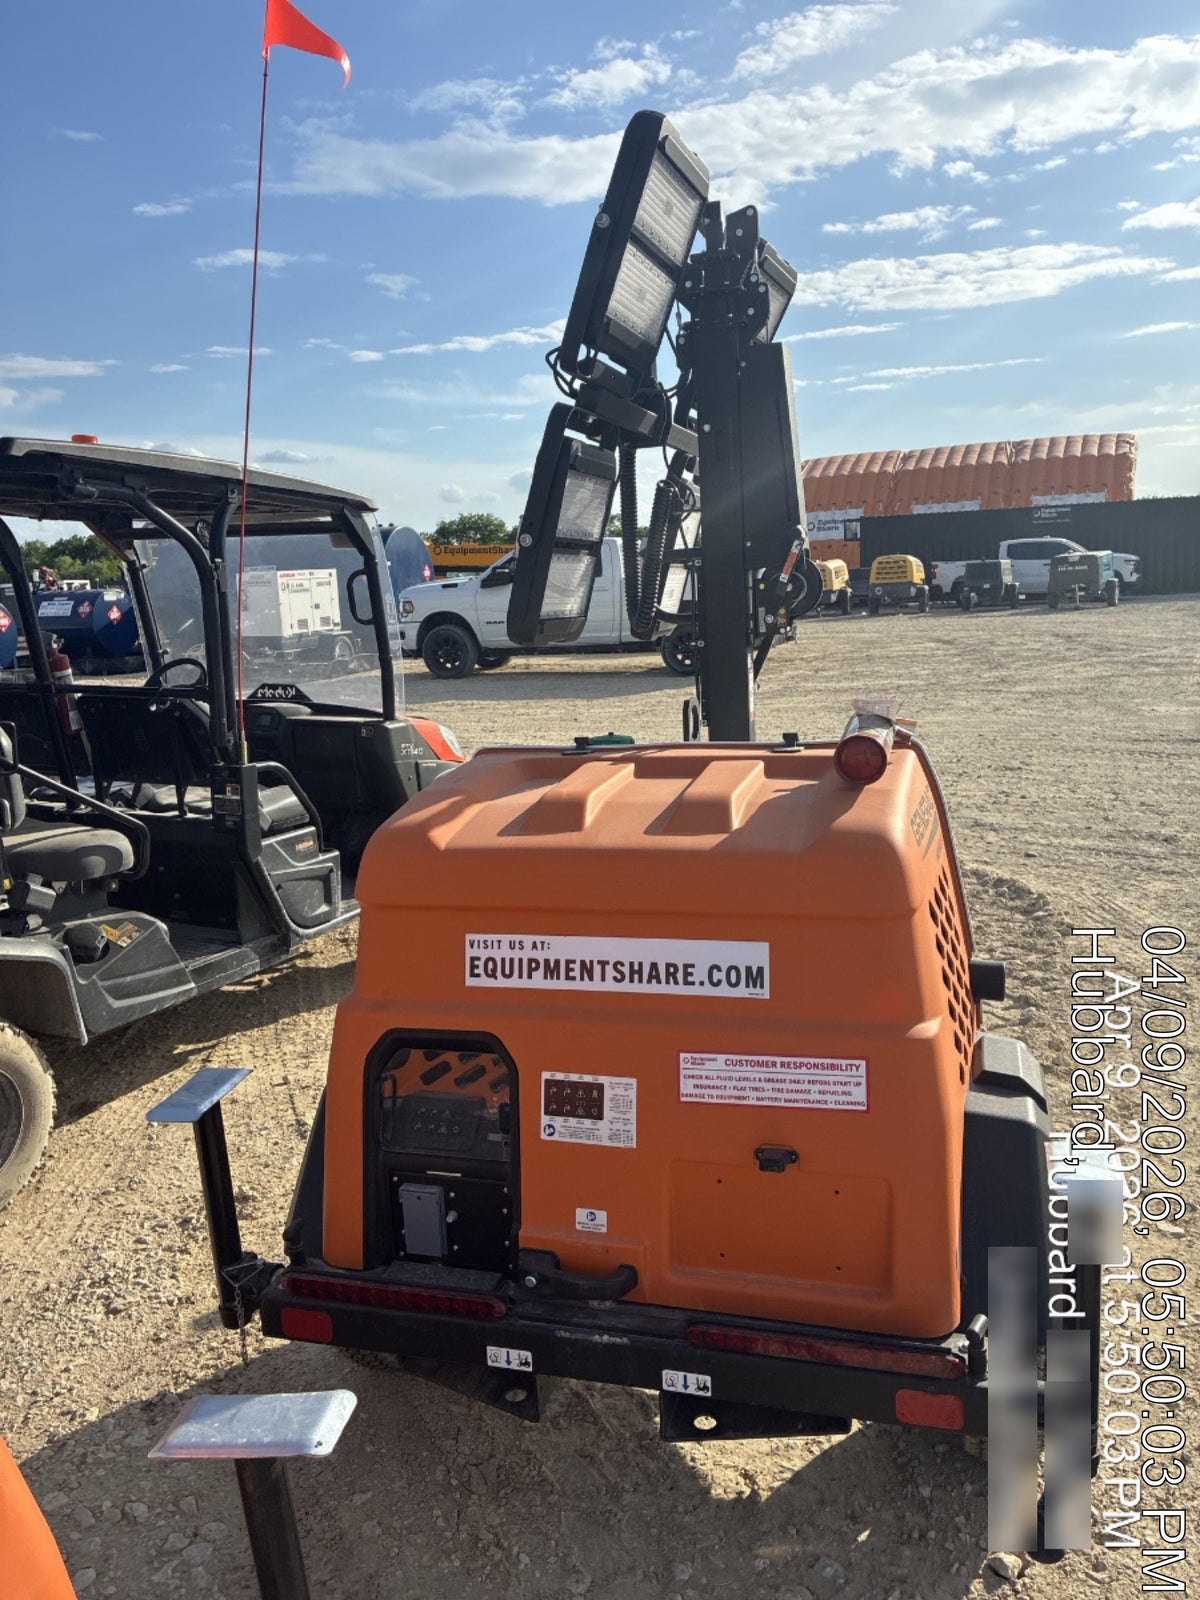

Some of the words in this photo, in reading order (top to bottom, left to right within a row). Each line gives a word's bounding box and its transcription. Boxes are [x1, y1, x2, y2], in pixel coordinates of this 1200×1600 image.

[443, 546, 516, 556] EquipmentSha
[468, 939, 503, 950] VISIT
[509, 940, 525, 950] US
[531, 941, 550, 951] AT:
[469, 956, 765, 989] EQUIPMENTSHARE.COM
[724, 1058, 778, 1069] CUSTOMER
[780, 1061, 861, 1073] RESPONSIBILITY
[693, 1083, 727, 1091] INSURANCE
[808, 1079, 831, 1087] BEFORE
[832, 1080, 852, 1088] START
[783, 1097, 828, 1106] MAINTENANCE
